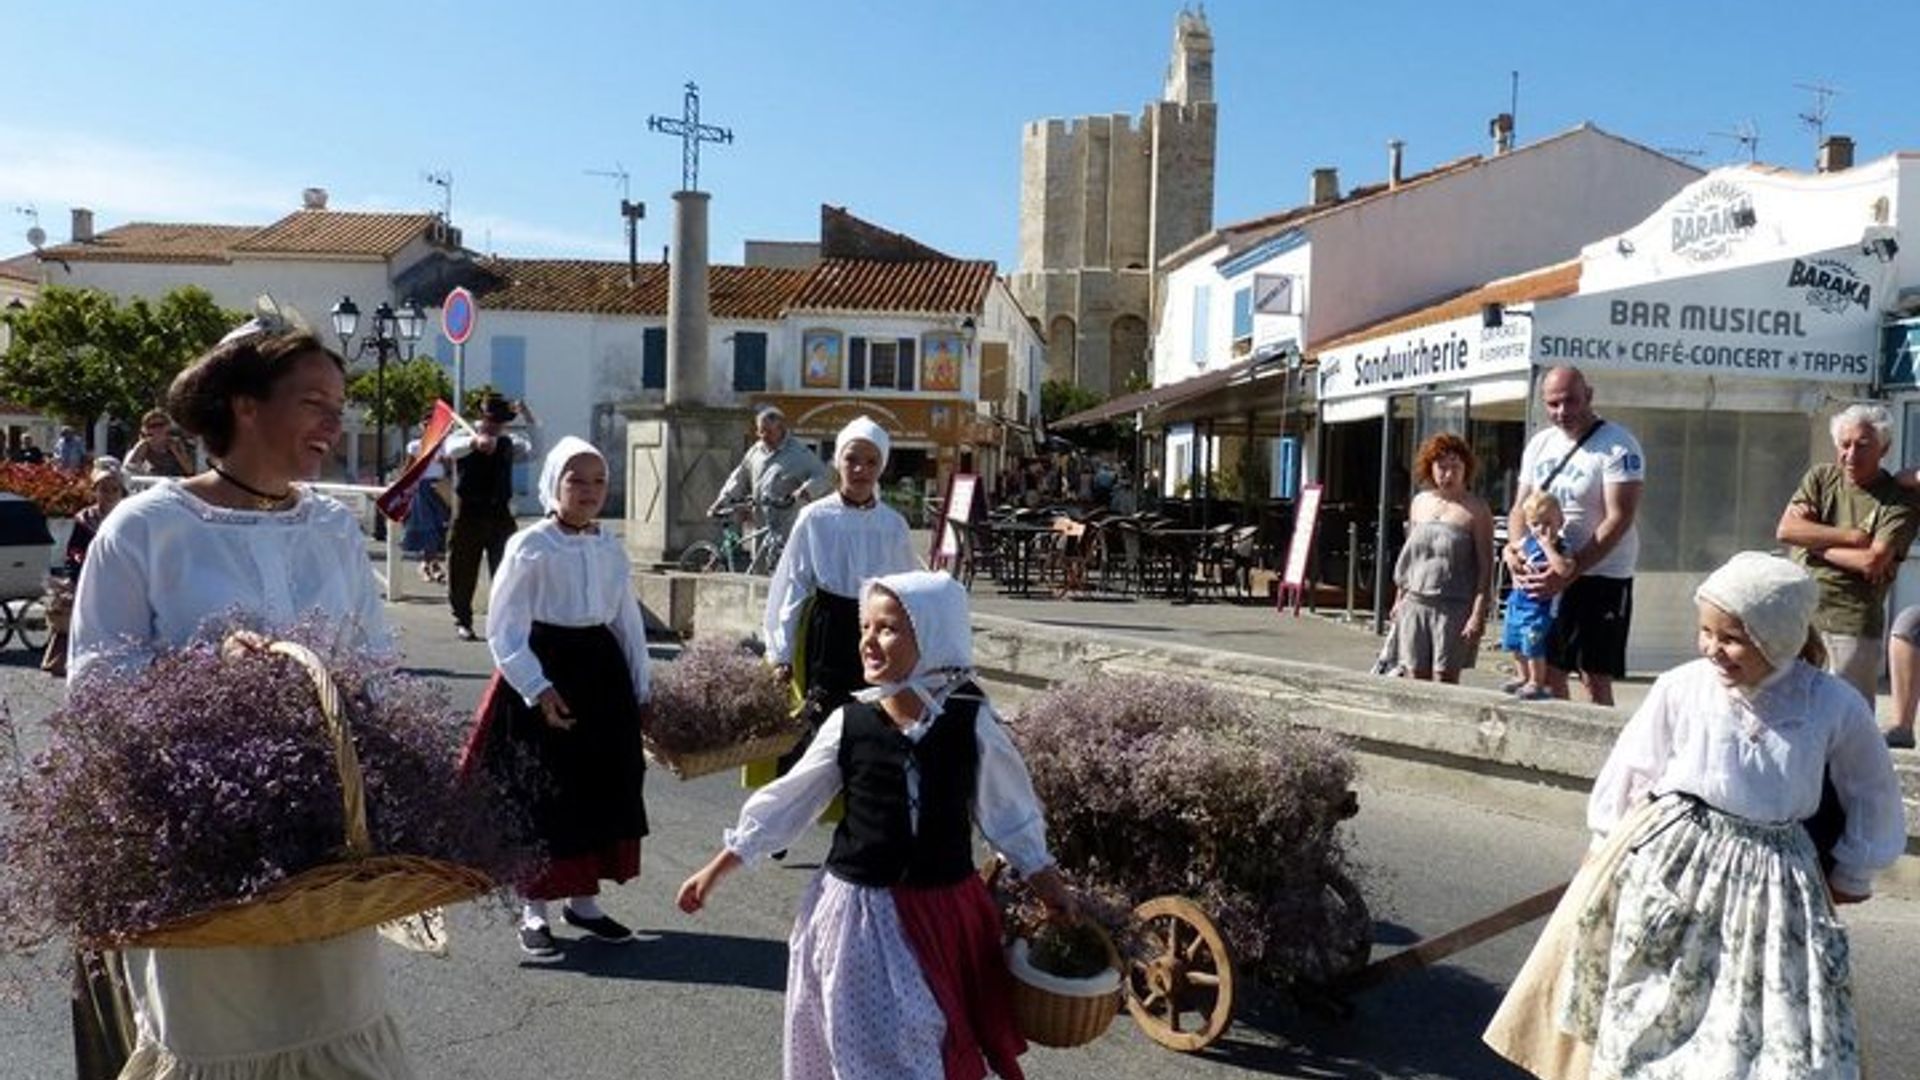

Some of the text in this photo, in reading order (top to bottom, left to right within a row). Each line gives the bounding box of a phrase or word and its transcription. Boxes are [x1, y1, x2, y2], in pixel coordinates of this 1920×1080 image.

[1672, 199, 1754, 253] BARAK
[1787, 259, 1871, 312] BARAKA
[1610, 300, 1807, 337] BAR MUSICAL
[1354, 332, 1468, 387] Sandwicherie
[1540, 335, 1612, 360] SNACK
[1802, 350, 1868, 374] TAPAS
